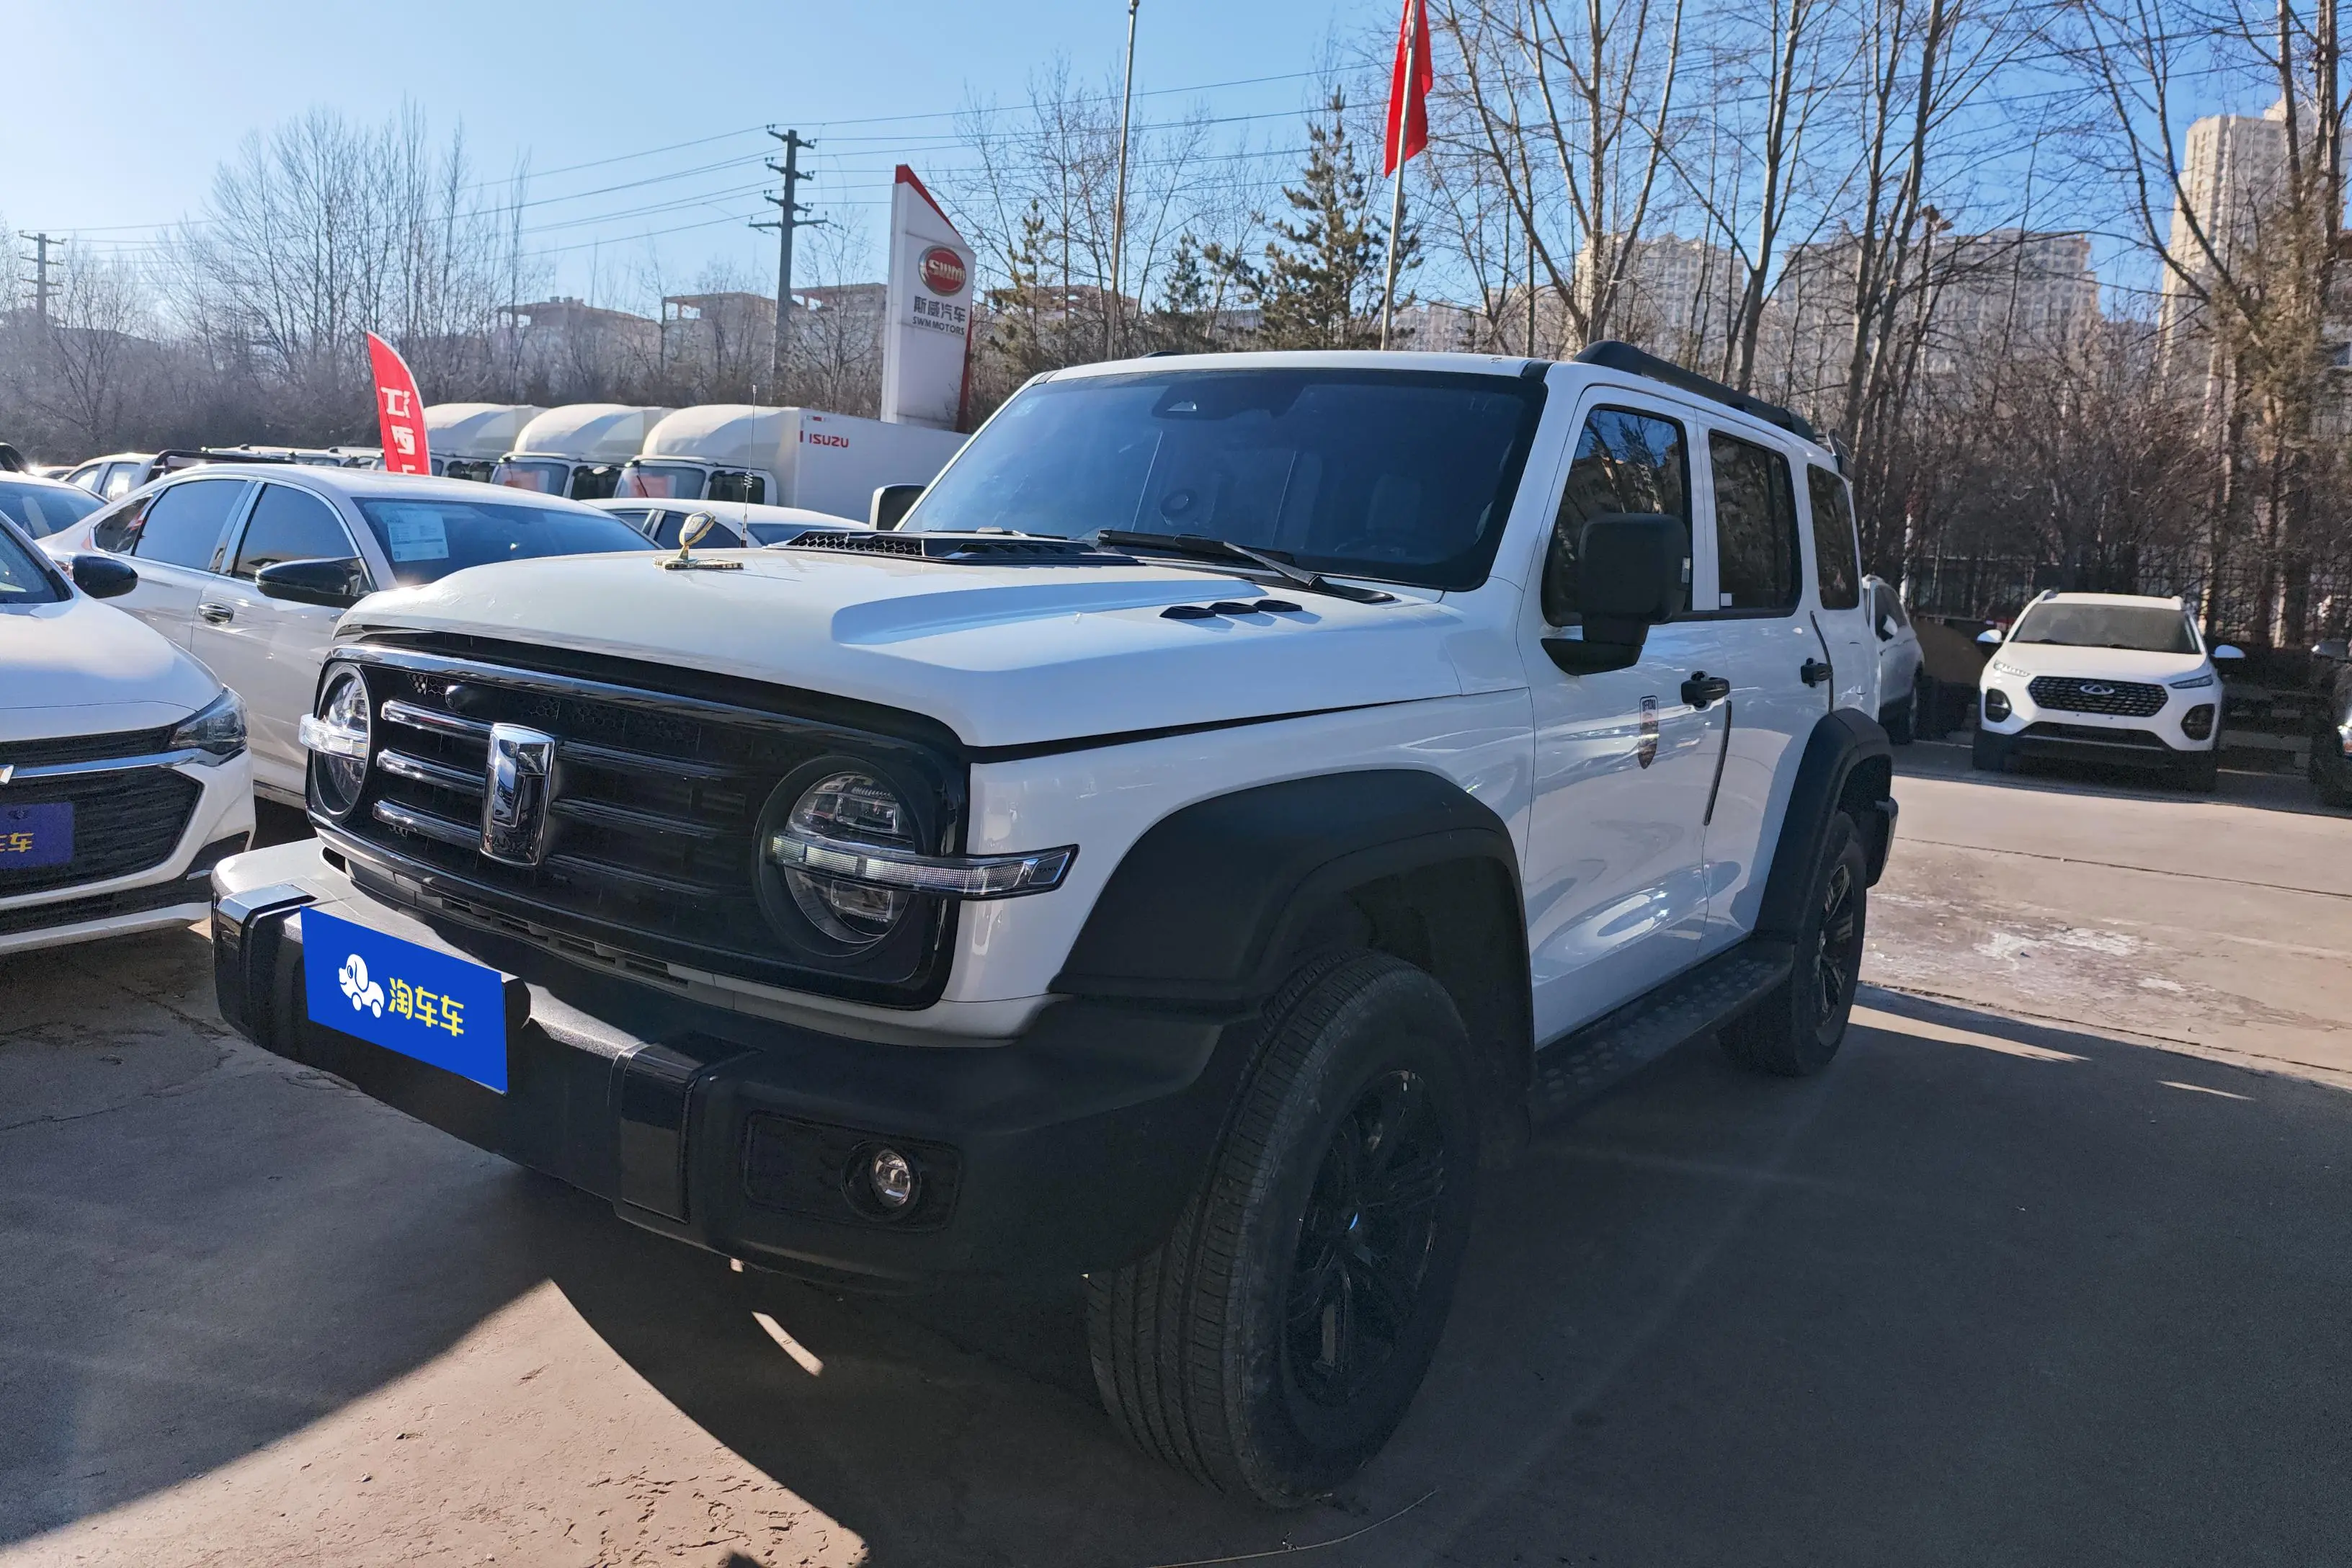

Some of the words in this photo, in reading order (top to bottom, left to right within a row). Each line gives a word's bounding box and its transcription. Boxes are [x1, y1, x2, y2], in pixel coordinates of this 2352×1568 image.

[914, 295, 966, 323] 斯威汽车
[932, 320, 965, 336] MOTORS
[809, 433, 849, 447] ISUZU
